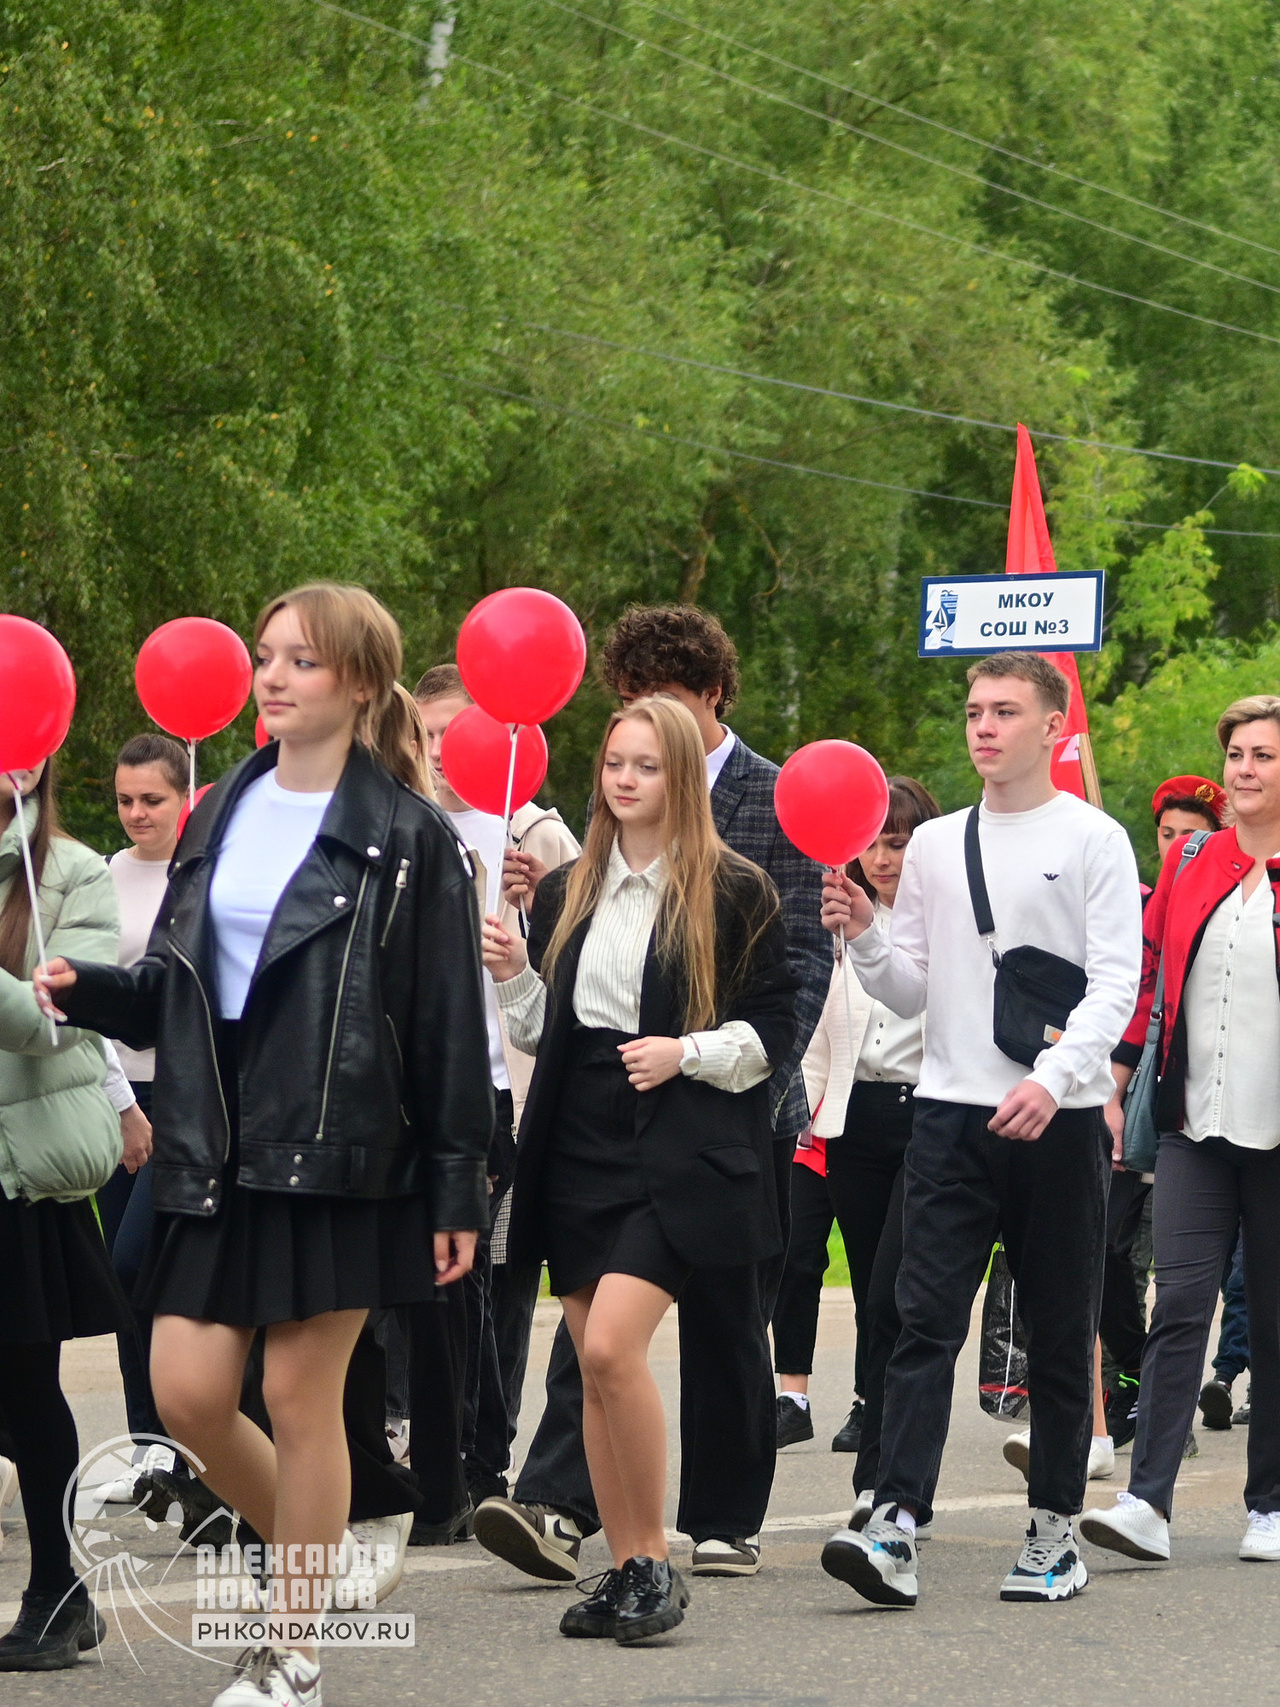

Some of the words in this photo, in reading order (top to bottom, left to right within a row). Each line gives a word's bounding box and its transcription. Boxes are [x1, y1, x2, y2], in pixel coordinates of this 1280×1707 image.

[998, 592, 1054, 608] МКОУ
[980, 621, 1027, 637] СОШ
[1035, 619, 1069, 635] №3
